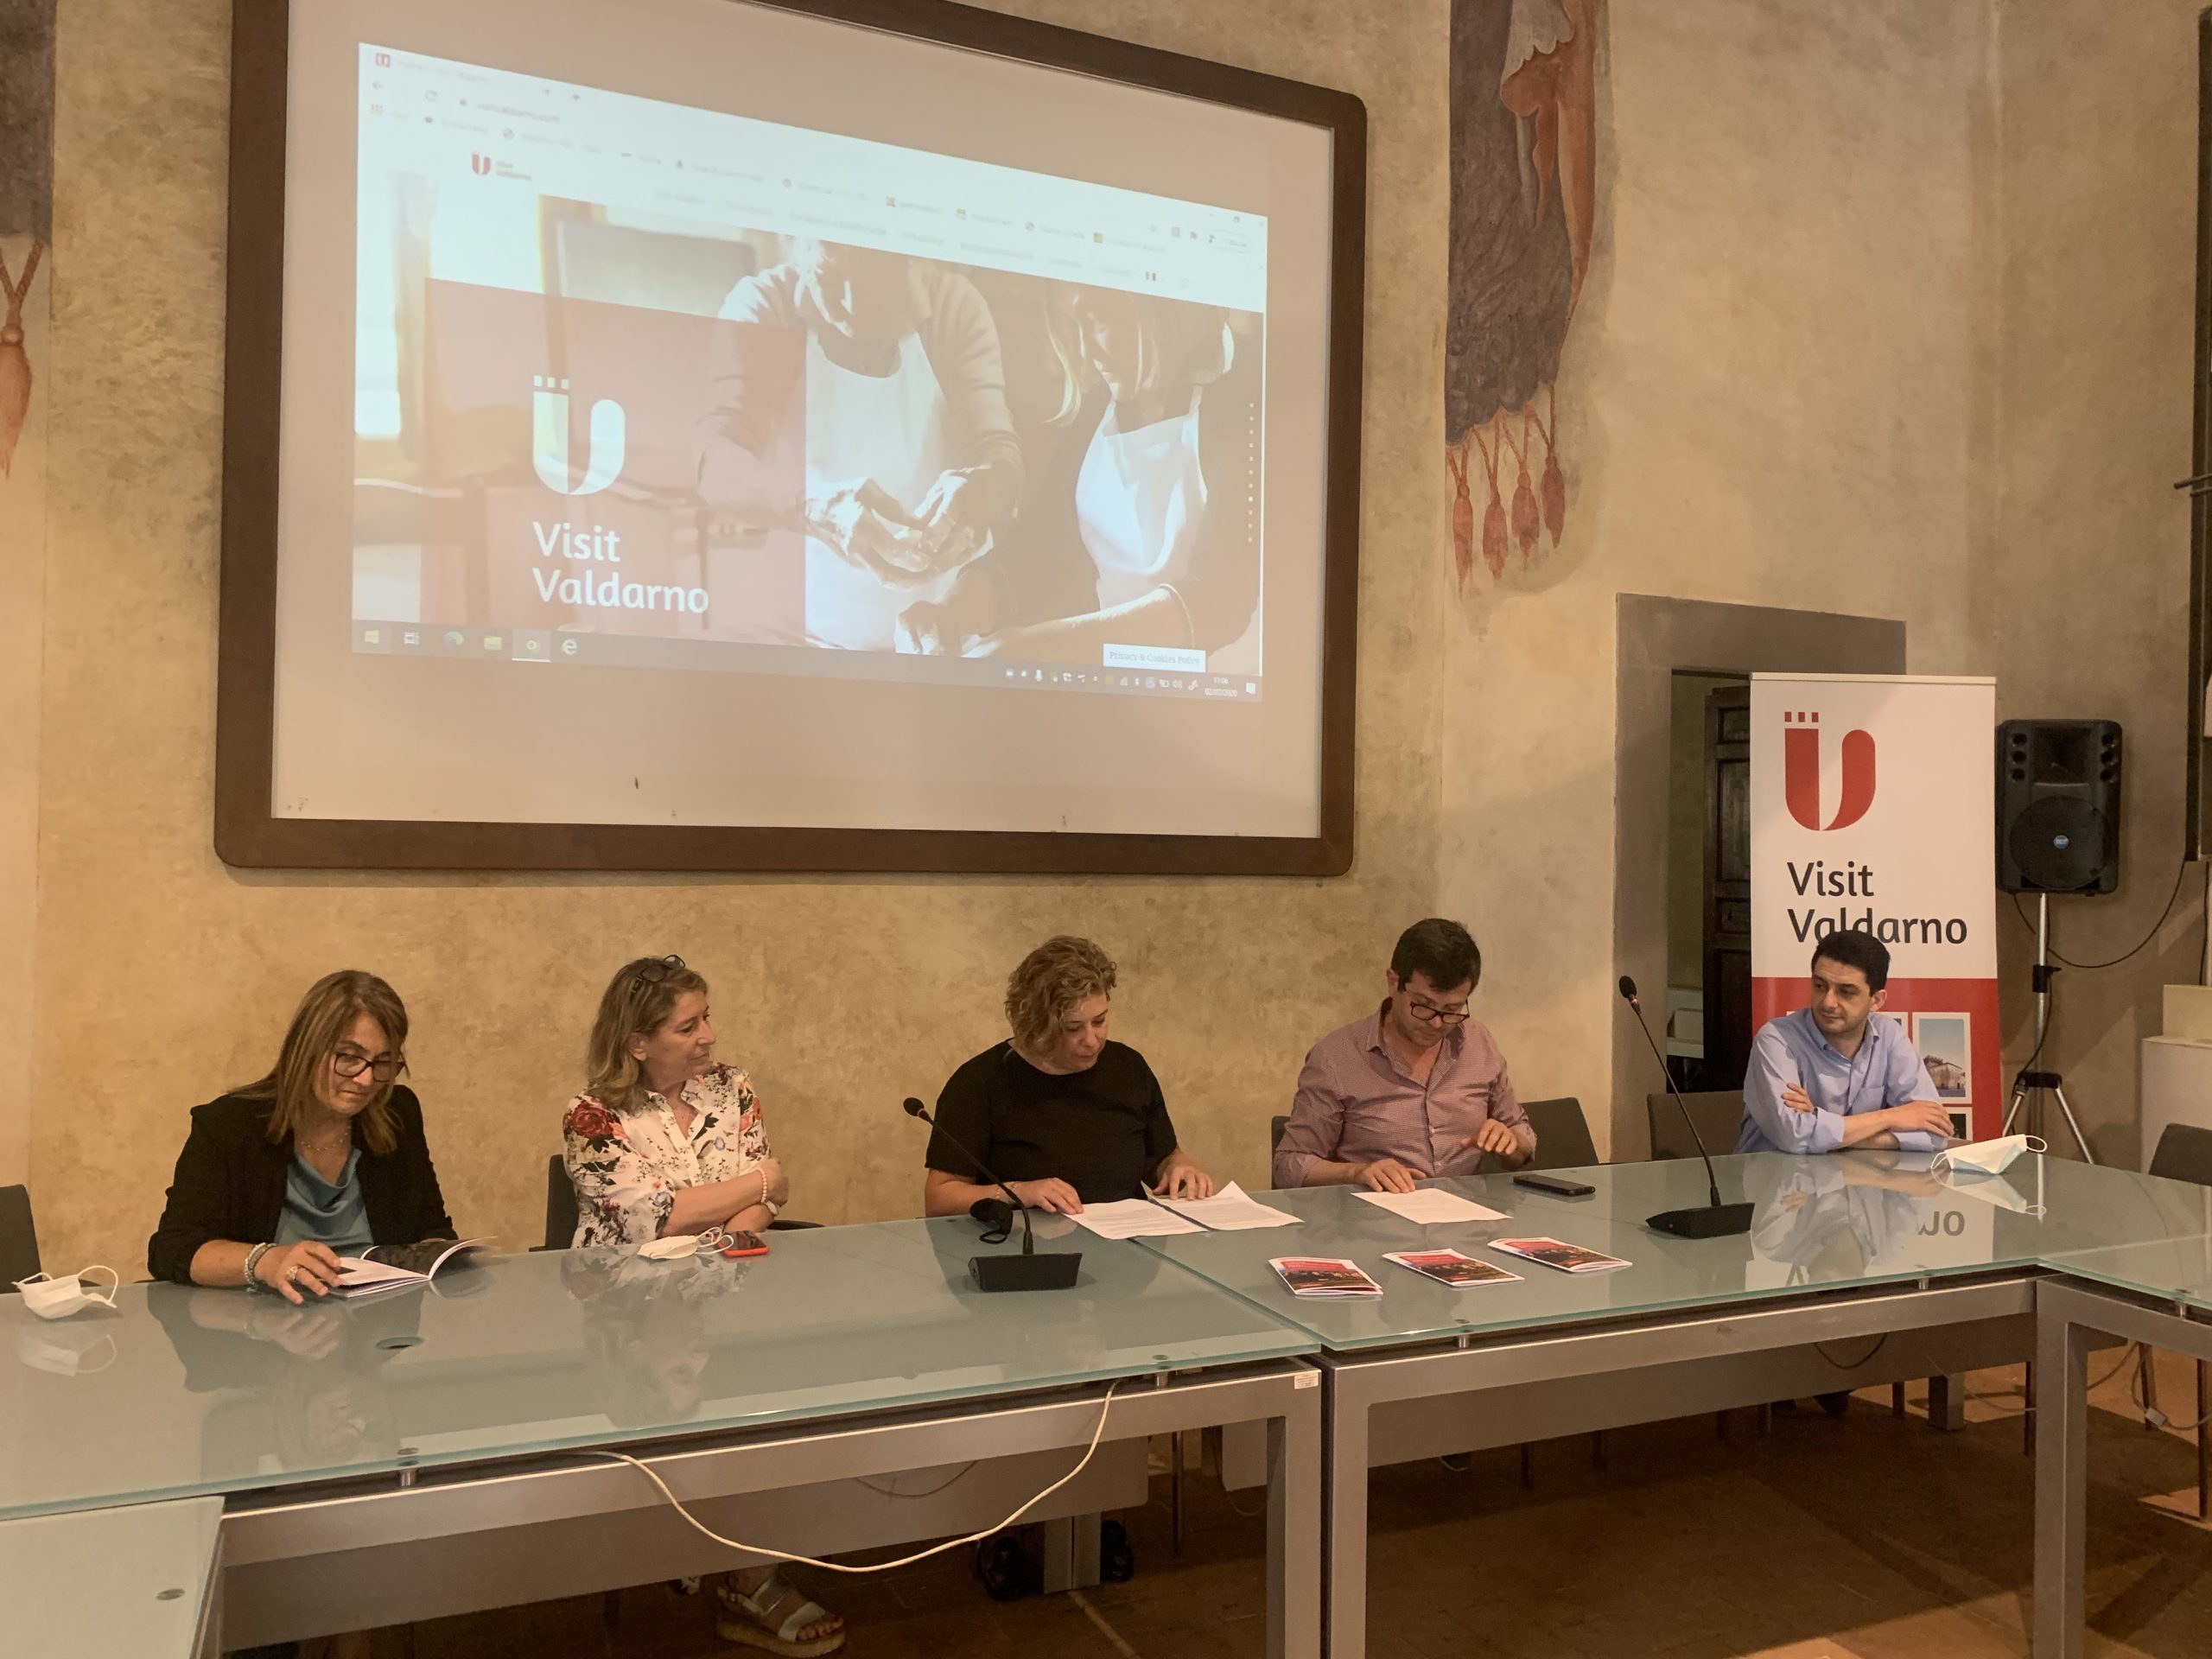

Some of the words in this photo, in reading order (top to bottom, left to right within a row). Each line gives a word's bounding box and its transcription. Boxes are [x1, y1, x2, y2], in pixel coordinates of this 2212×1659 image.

[532, 522, 620, 562] Visit
[532, 568, 709, 613] Valdarno
[1786, 861, 1874, 896] Visit
[1787, 907, 1967, 944] Valdarno
